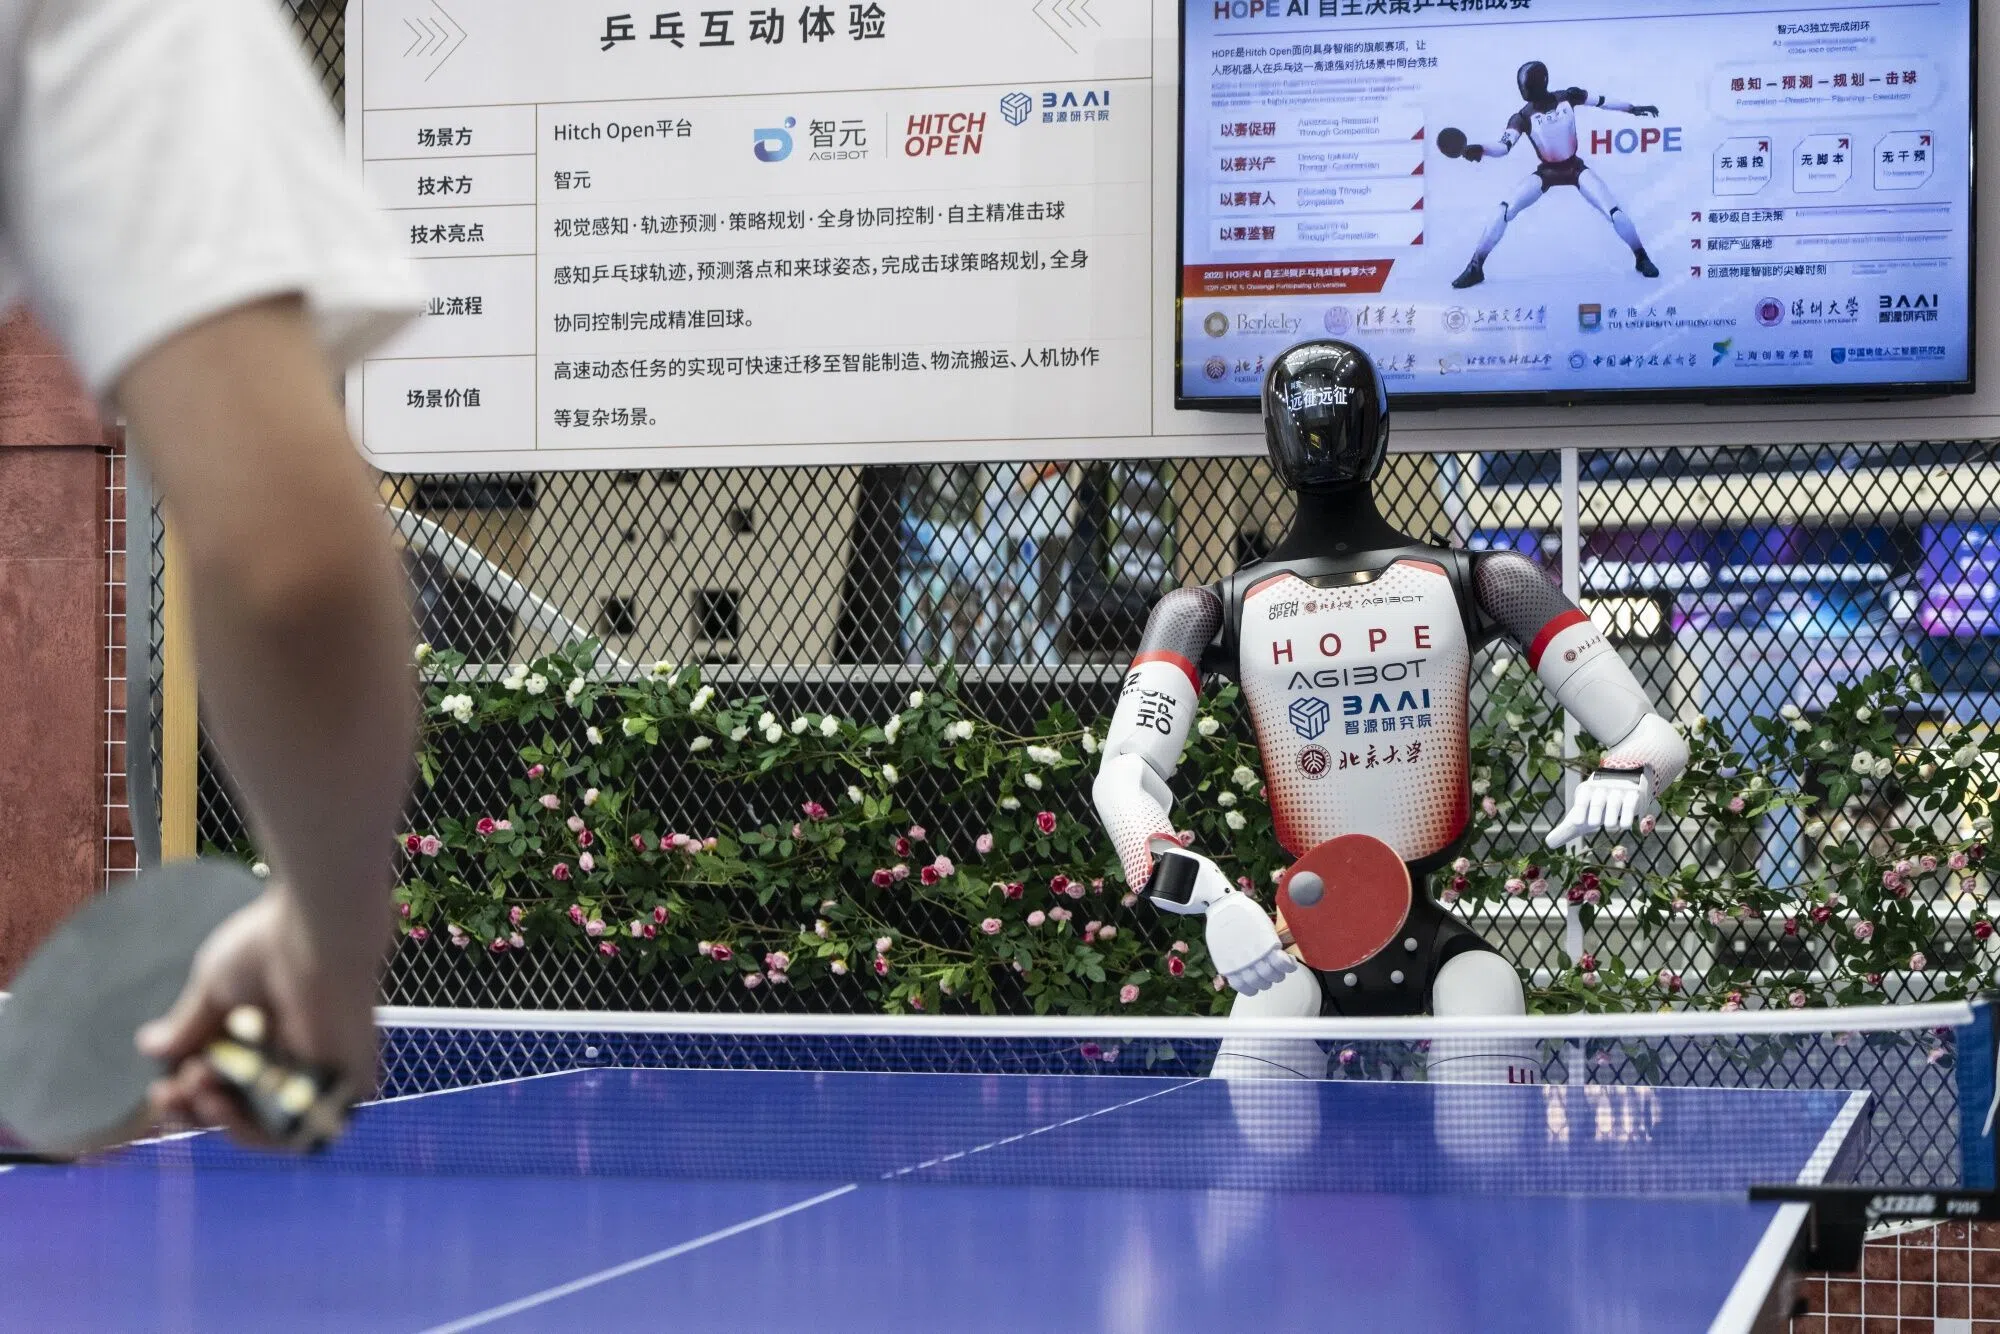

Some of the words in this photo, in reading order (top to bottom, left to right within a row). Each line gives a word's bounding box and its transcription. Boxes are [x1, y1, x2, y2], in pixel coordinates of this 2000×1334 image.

[1214, 0, 1280, 19] HOPE
[1287, 0, 1309, 17] AI
[599, 2, 887, 52] 乒乓互动体验
[1777, 21, 1870, 35] 智元A3独立完成闭环
[1042, 90, 1110, 108] BAAI
[906, 112, 986, 136] HITCH
[1042, 109, 1110, 123] 智源研究院
[417, 126, 473, 148] 场景方
[553, 123, 601, 142] Hitch
[606, 117, 693, 143] Open平台
[808, 118, 868, 149] 智元
[1220, 121, 1277, 137] 以赛促研
[904, 133, 984, 158] OPEN
[1591, 127, 1683, 155] HOPE
[808, 150, 869, 161] AGIBOT
[1220, 156, 1276, 172] 以赛兴产
[1721, 155, 1764, 169] 无遥控
[1801, 153, 1844, 166] 无脚本
[1882, 150, 1926, 163] 无干预
[417, 175, 473, 196] 技术方
[553, 170, 591, 190] 智元
[1220, 191, 1276, 207] 以赛育人
[1707, 210, 1784, 224] 毫秒级自主决策
[410, 223, 485, 244] 技术亮点
[1220, 225, 1276, 241] 以赛鉴智
[1707, 237, 1773, 251] 赋能产业落地
[1707, 264, 1828, 279] 创造物理智能的尖峰时刻
[1879, 294, 1938, 308] BAAI
[553, 308, 753, 333] 协同控制完成精准回球。
[1237, 312, 1302, 334] Berkeley
[1879, 310, 1938, 323] 智源研究院
[406, 388, 481, 409] 场景价值
[553, 407, 657, 428] 等复杂场景。
[1269, 600, 1299, 614] HITCH
[1361, 595, 1424, 607] AGIBOT
[1268, 609, 1298, 621] OPEN
[1272, 625, 1432, 665] HOPE
[1288, 659, 1427, 690] AGIBOT
[1343, 689, 1431, 716] BAAI
[1344, 713, 1432, 735] 智源研究院
[1338, 739, 1422, 770] 北京大学
